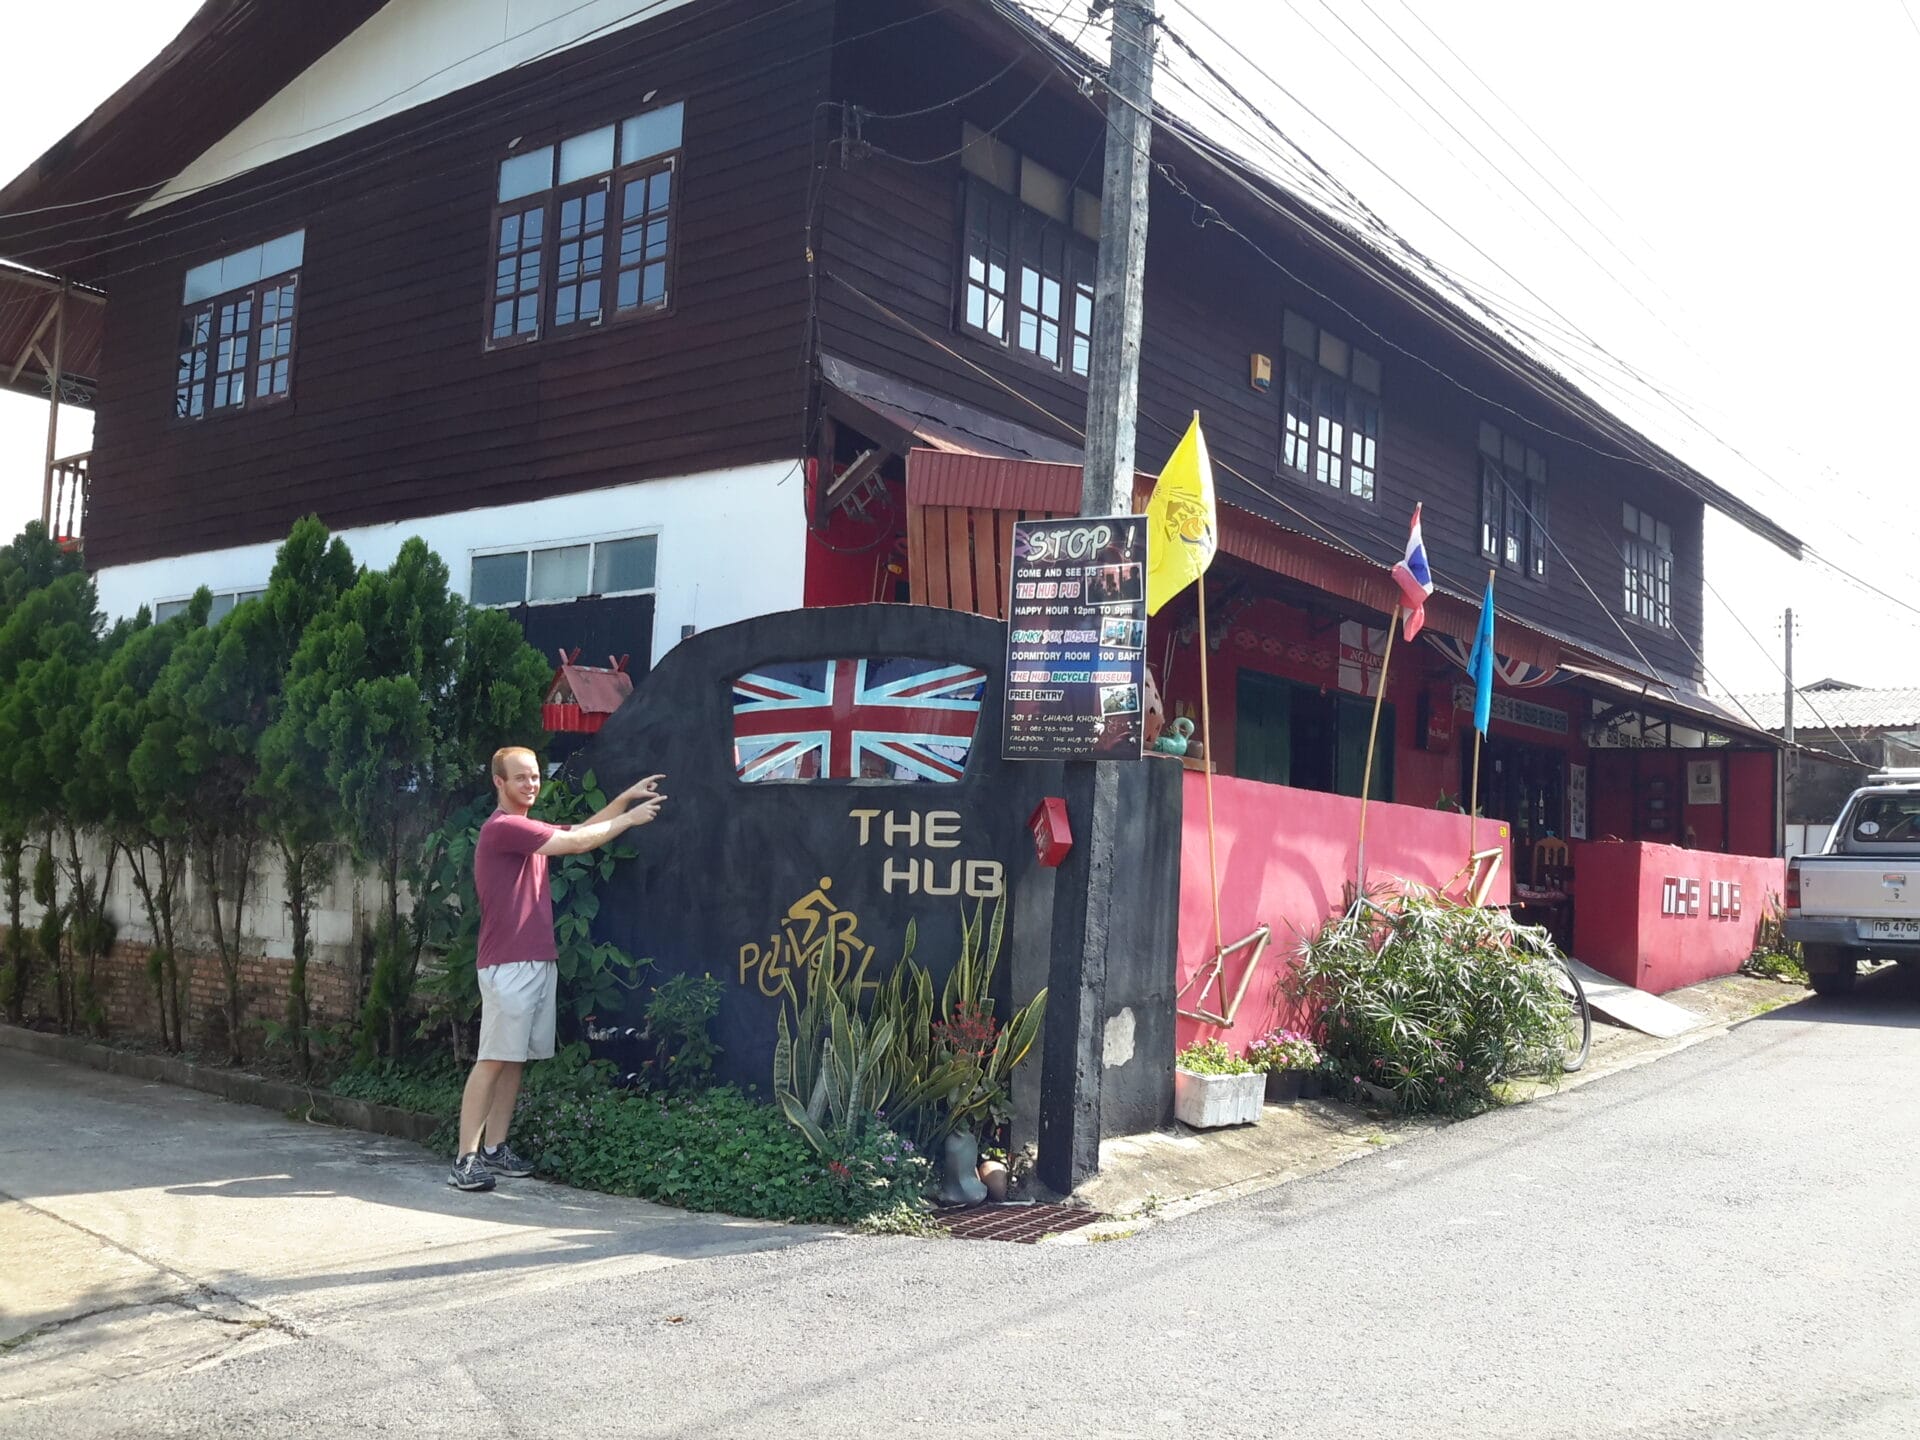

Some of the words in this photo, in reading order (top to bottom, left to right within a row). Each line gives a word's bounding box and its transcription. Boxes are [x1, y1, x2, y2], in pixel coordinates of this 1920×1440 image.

[1027, 525, 1111, 561] STOP
[1017, 568, 1041, 578] COME
[1044, 568, 1062, 577] AND
[1065, 567, 1082, 577] SEE
[1016, 583, 1035, 598] THE
[1036, 582, 1058, 598] HUB
[1059, 582, 1080, 598] PUB
[1015, 606, 1042, 616] HAPPY
[1045, 606, 1069, 615] HOUR
[1073, 606, 1096, 617] 12pm
[1100, 606, 1110, 615] TO
[1011, 630, 1042, 643] FUNKY
[1064, 629, 1099, 644] HOSTEL
[1011, 652, 1061, 661] DORMITORY
[1065, 652, 1090, 661] ROOM
[1118, 652, 1141, 661] BAHT
[1011, 672, 1029, 682] THE
[1029, 672, 1050, 683] HUB
[1052, 672, 1090, 683] BICYCLE
[1090, 672, 1132, 683] MUSEUM
[1009, 690, 1032, 700] FREE
[1034, 690, 1063, 700] ENTRY
[1043, 714, 1074, 722] CHIANG
[1076, 714, 1105, 723] KHONG
[849, 809, 962, 848] THE
[1866, 823, 1873, 832] T
[883, 857, 1004, 898] HUB
[1662, 875, 1700, 915] THE
[1709, 880, 1742, 917] HUB
[1893, 922, 1919, 932] 4705
